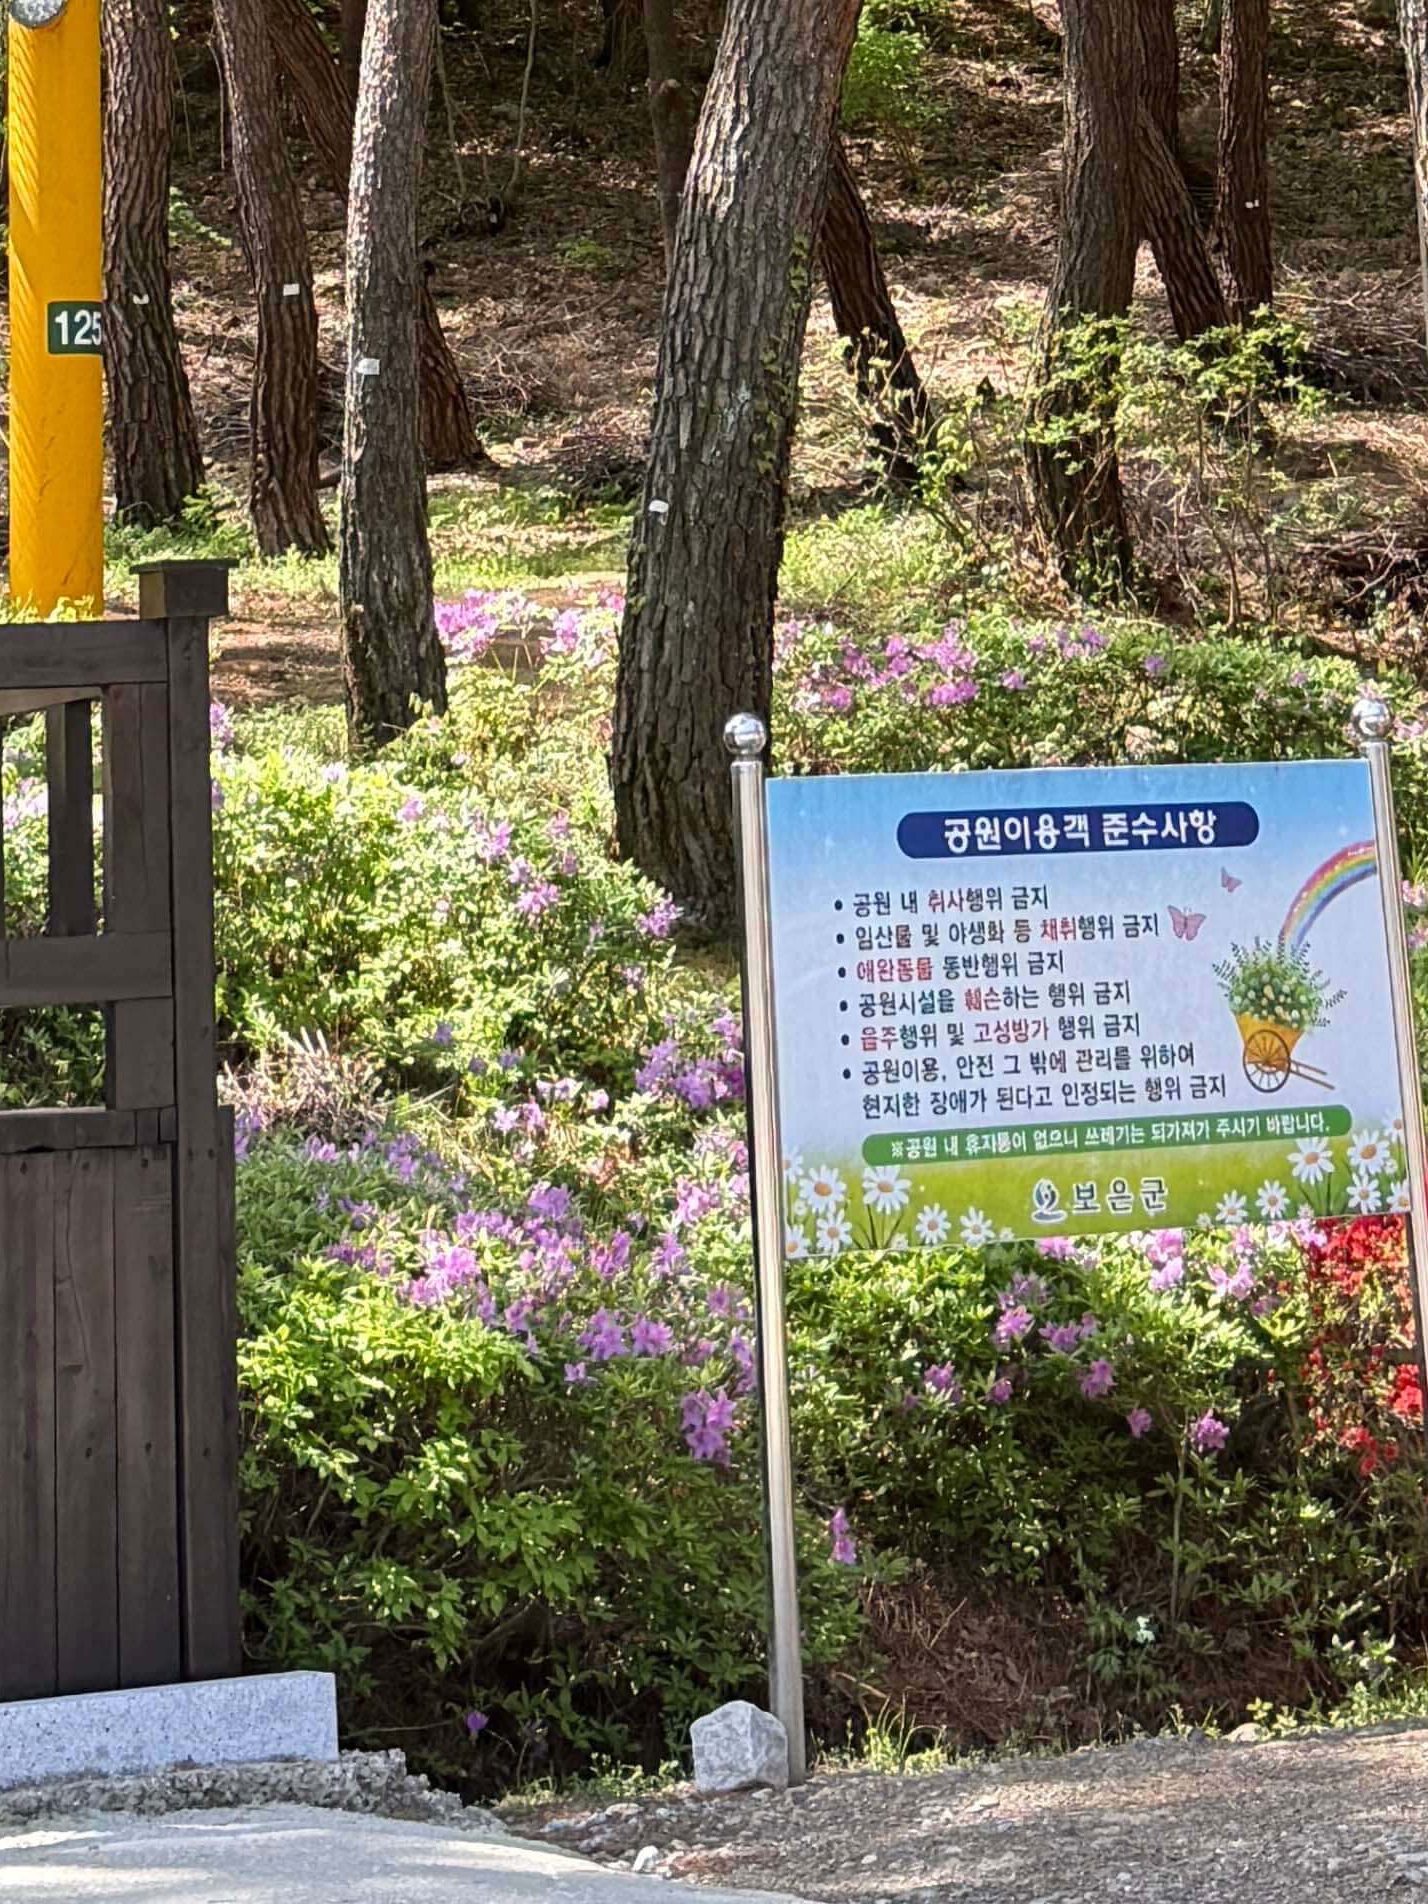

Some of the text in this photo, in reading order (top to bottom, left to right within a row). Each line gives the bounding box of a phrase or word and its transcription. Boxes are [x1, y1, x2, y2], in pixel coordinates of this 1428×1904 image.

[55, 309, 102, 345] 125
[943, 809, 1217, 854] 공원이용객 준수사항
[853, 885, 1049, 918] 공원 내 취사행위 금지
[855, 913, 1159, 951] 임산물 및 야생화 등 채취행위 금지
[856, 950, 1064, 983] 애완동물 동반행위 금지
[859, 980, 1131, 1018] 공원시설을 훼손하는 행위 금지
[860, 1012, 1140, 1052] 음주행위 및 고성방가 행위 금지
[862, 1042, 1195, 1086] 공원이용, 안전 그 밖에 관리를 위하여
[930, 1088, 987, 1116] 장애가
[996, 1085, 1053, 1112] 된다고
[1061, 1079, 1136, 1108] 인정되는
[1145, 1076, 1182, 1103] 행위
[1190, 1073, 1227, 1099] 금지
[944, 1135, 960, 1156] 내
[1033, 1128, 1079, 1151] 없으니
[1084, 1123, 1145, 1146] 쓰레기는
[1216, 1116, 1261, 1139] 주시기
